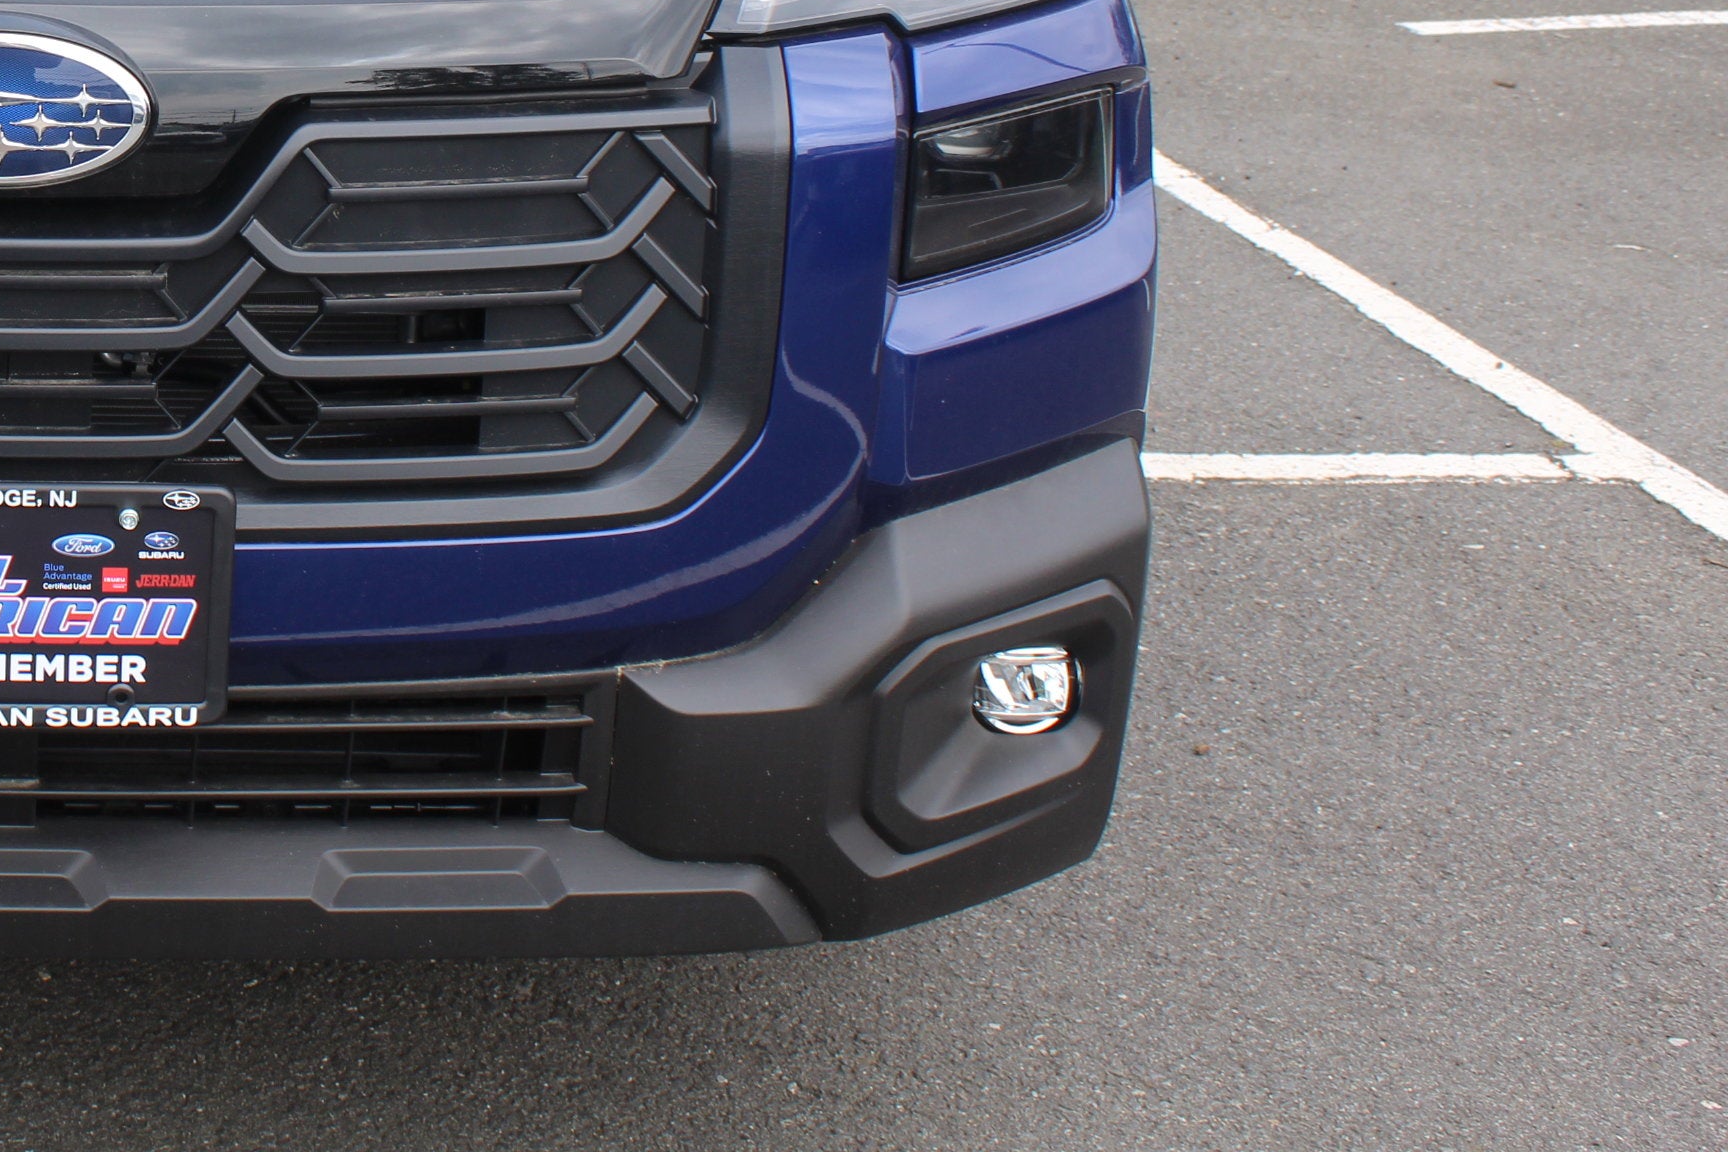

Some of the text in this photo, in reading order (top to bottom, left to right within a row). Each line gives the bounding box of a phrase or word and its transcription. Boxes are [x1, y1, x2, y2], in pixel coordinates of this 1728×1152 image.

[49, 490, 78, 508] NJ
[65, 537, 102, 554] Ford
[138, 551, 185, 560] SUBARU
[43, 563, 65, 572] Blue
[43, 572, 93, 582] Advantage
[42, 582, 92, 591] Certified Used
[45, 707, 198, 728] SUBARU
